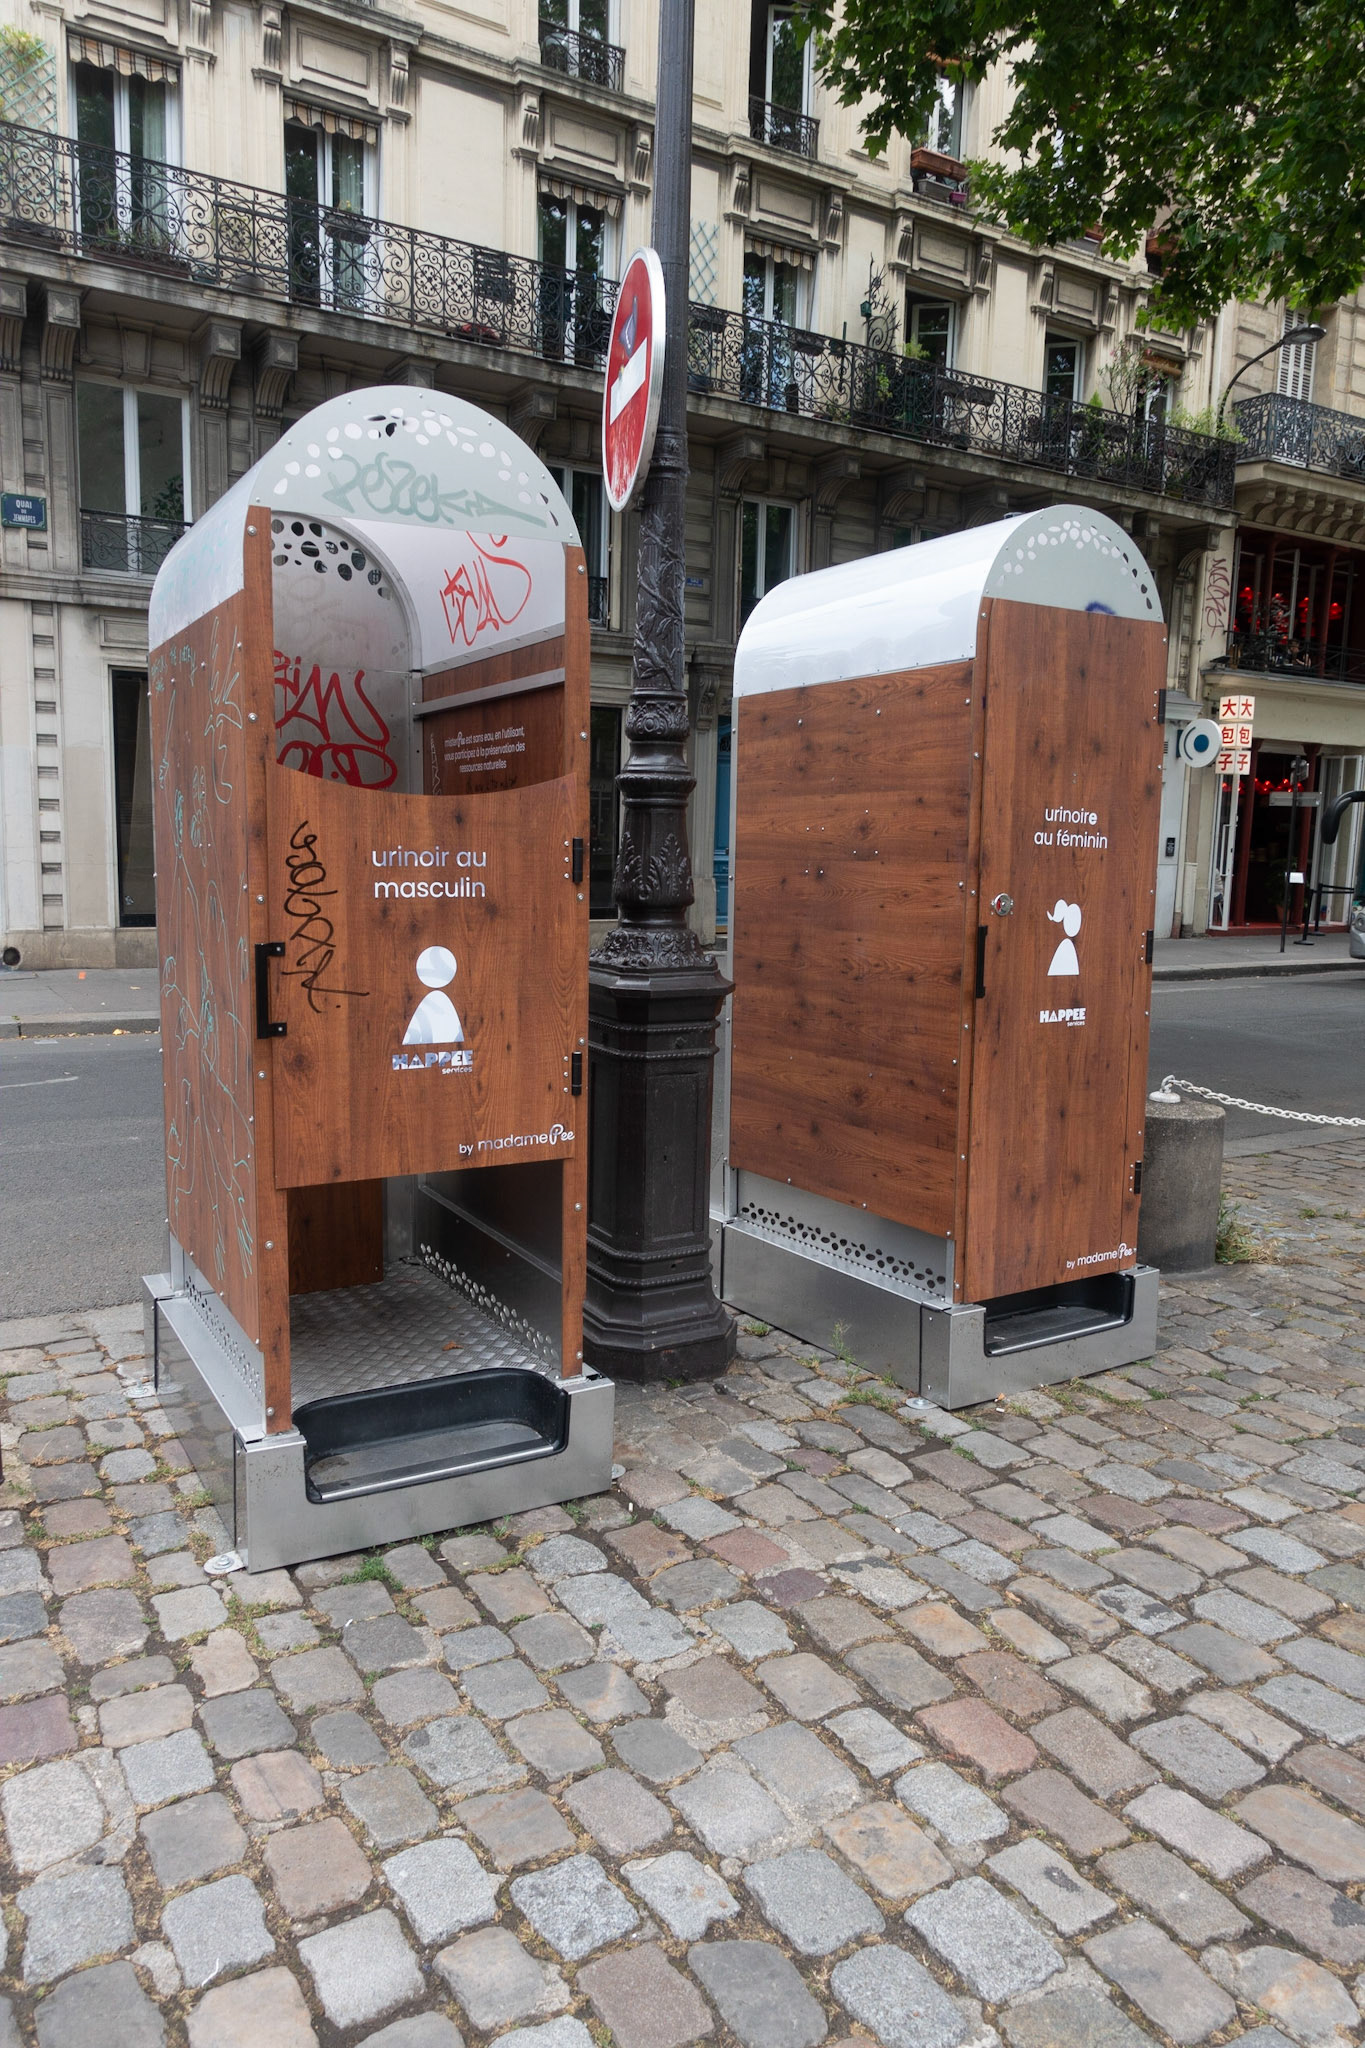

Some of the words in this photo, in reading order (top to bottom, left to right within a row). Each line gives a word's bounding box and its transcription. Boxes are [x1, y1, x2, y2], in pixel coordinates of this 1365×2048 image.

[16, 500, 32, 509] QUAI
[473, 734, 484, 744] sans
[495, 731, 501, 740] en
[1237, 698, 1253, 772] 大包子
[444, 752, 455, 761] vous
[455, 747, 475, 762] participez
[480, 746, 485, 757] la
[485, 742, 515, 759] préservation
[516, 741, 526, 752] des
[460, 763, 483, 773] ressources
[483, 759, 507, 771] naturelles
[1045, 806, 1098, 826] urinoire
[1034, 831, 1053, 846] au
[1056, 829, 1108, 849] féminin
[372, 845, 449, 868] urinoir
[456, 850, 487, 868] au
[374, 876, 486, 899] masculin
[1040, 1007, 1087, 1024] HAPPEE
[392, 1049, 474, 1071] HAPPEE
[441, 1066, 473, 1075] services
[459, 1143, 474, 1156] by
[1066, 1260, 1076, 1270] by
